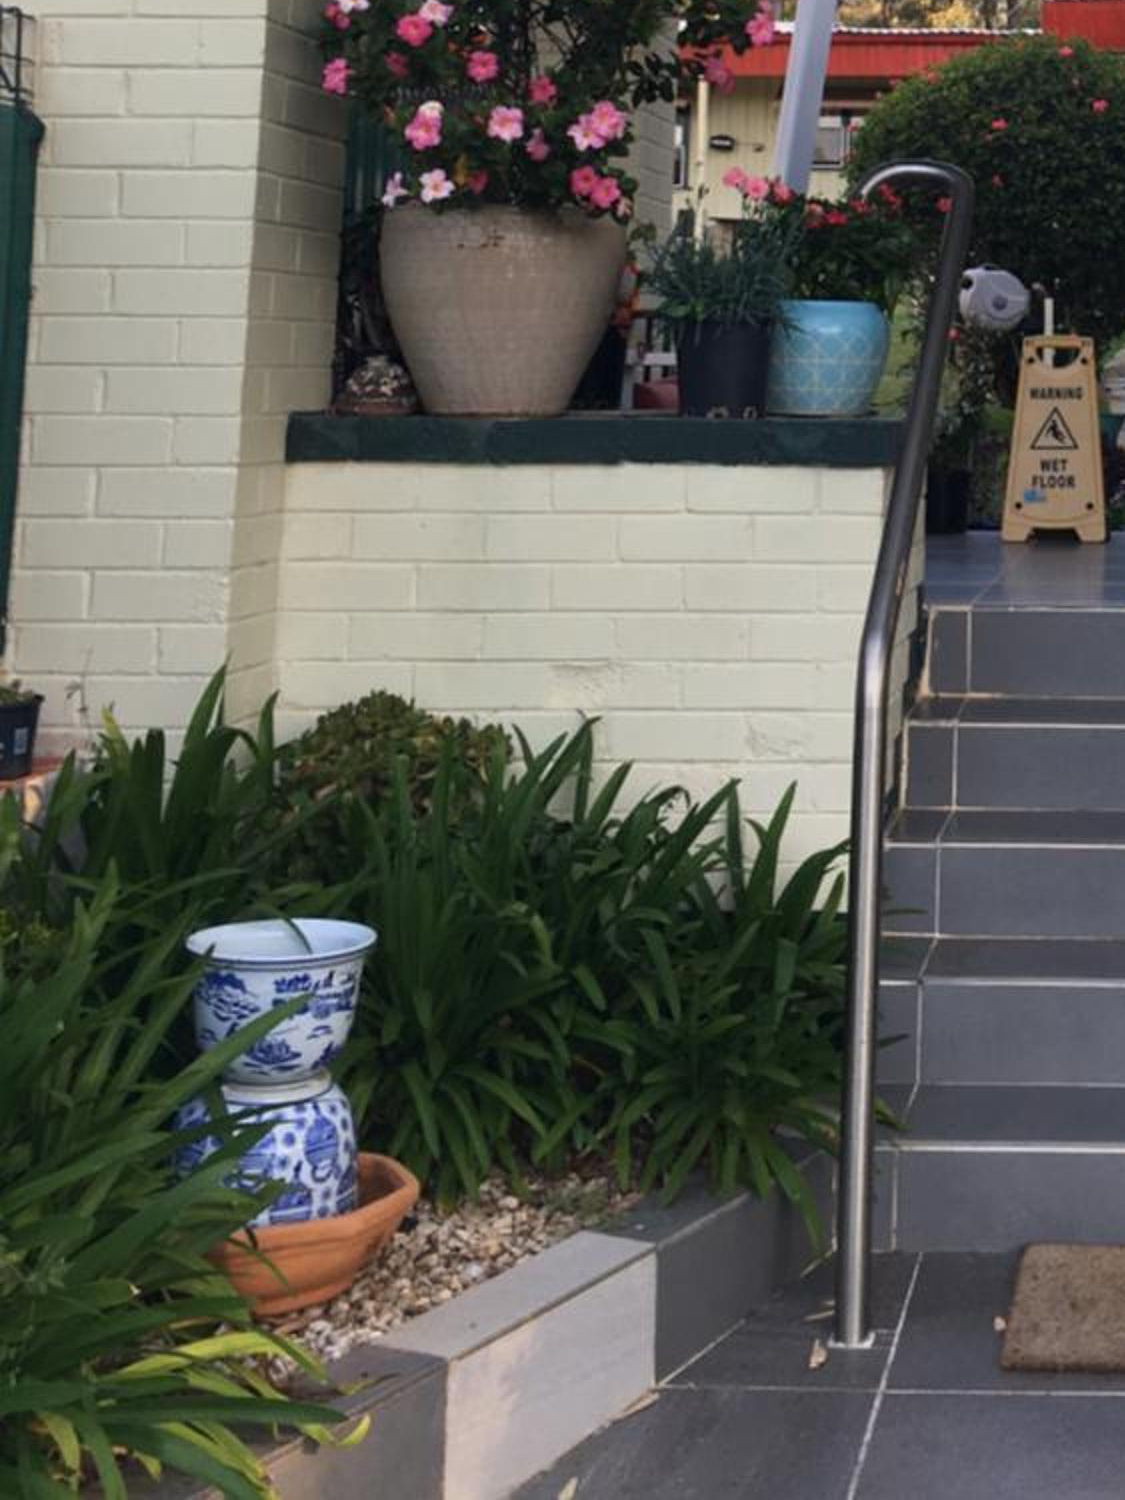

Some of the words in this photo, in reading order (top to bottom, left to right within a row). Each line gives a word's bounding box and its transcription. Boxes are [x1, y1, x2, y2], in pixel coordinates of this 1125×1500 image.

[1029, 387, 1083, 401] WARNING
[1040, 458, 1068, 473] WET
[1031, 475, 1076, 489] FLOOR
